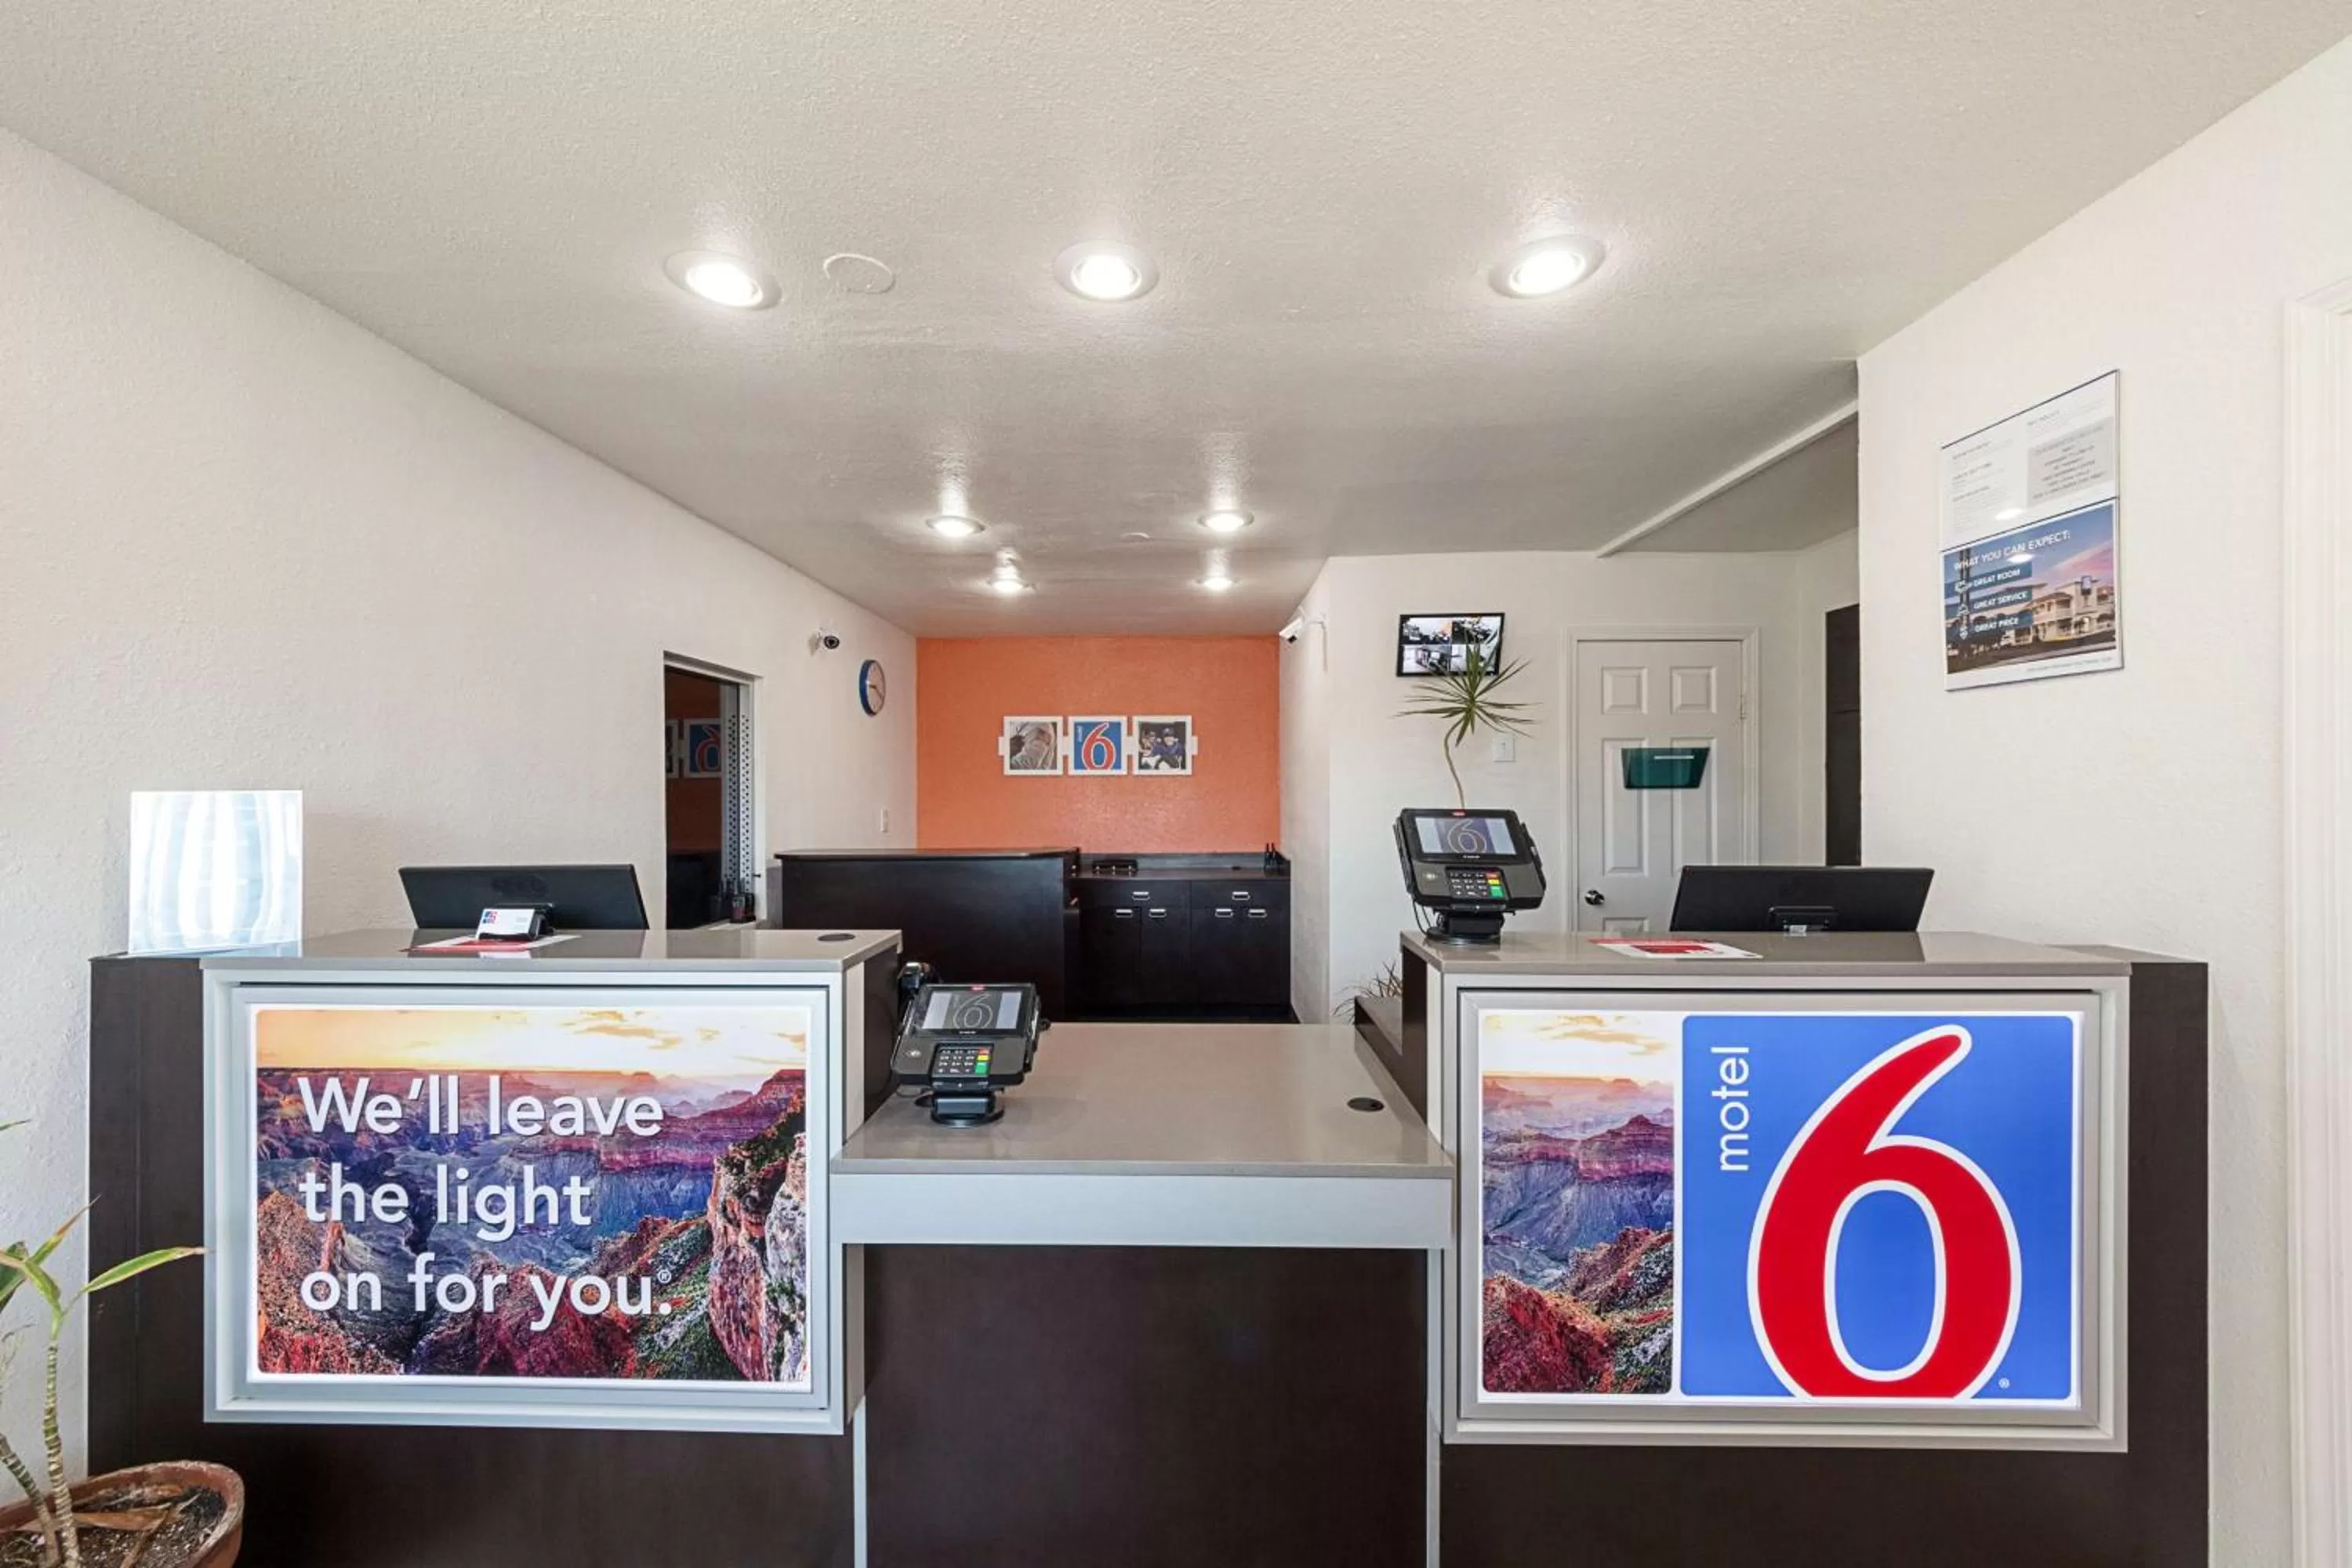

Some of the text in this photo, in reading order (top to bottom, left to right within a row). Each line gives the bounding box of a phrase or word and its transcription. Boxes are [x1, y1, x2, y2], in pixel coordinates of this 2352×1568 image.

[1955, 529, 2071, 571] WHAT YOU CAN EXPECT:
[1973, 568, 2020, 586] GREAT ROOM
[1999, 617, 2020, 629] PRICE
[1082, 722, 1116, 771] 6
[1448, 818, 1487, 853] 6
[953, 993, 993, 1029] 6
[297, 1074, 663, 1137] We'll leave
[1710, 1045, 1751, 1172] motel
[298, 1163, 592, 1243] the light
[1747, 1024, 2023, 1399] 6
[299, 1271, 383, 1312] on
[408, 1253, 506, 1314] for
